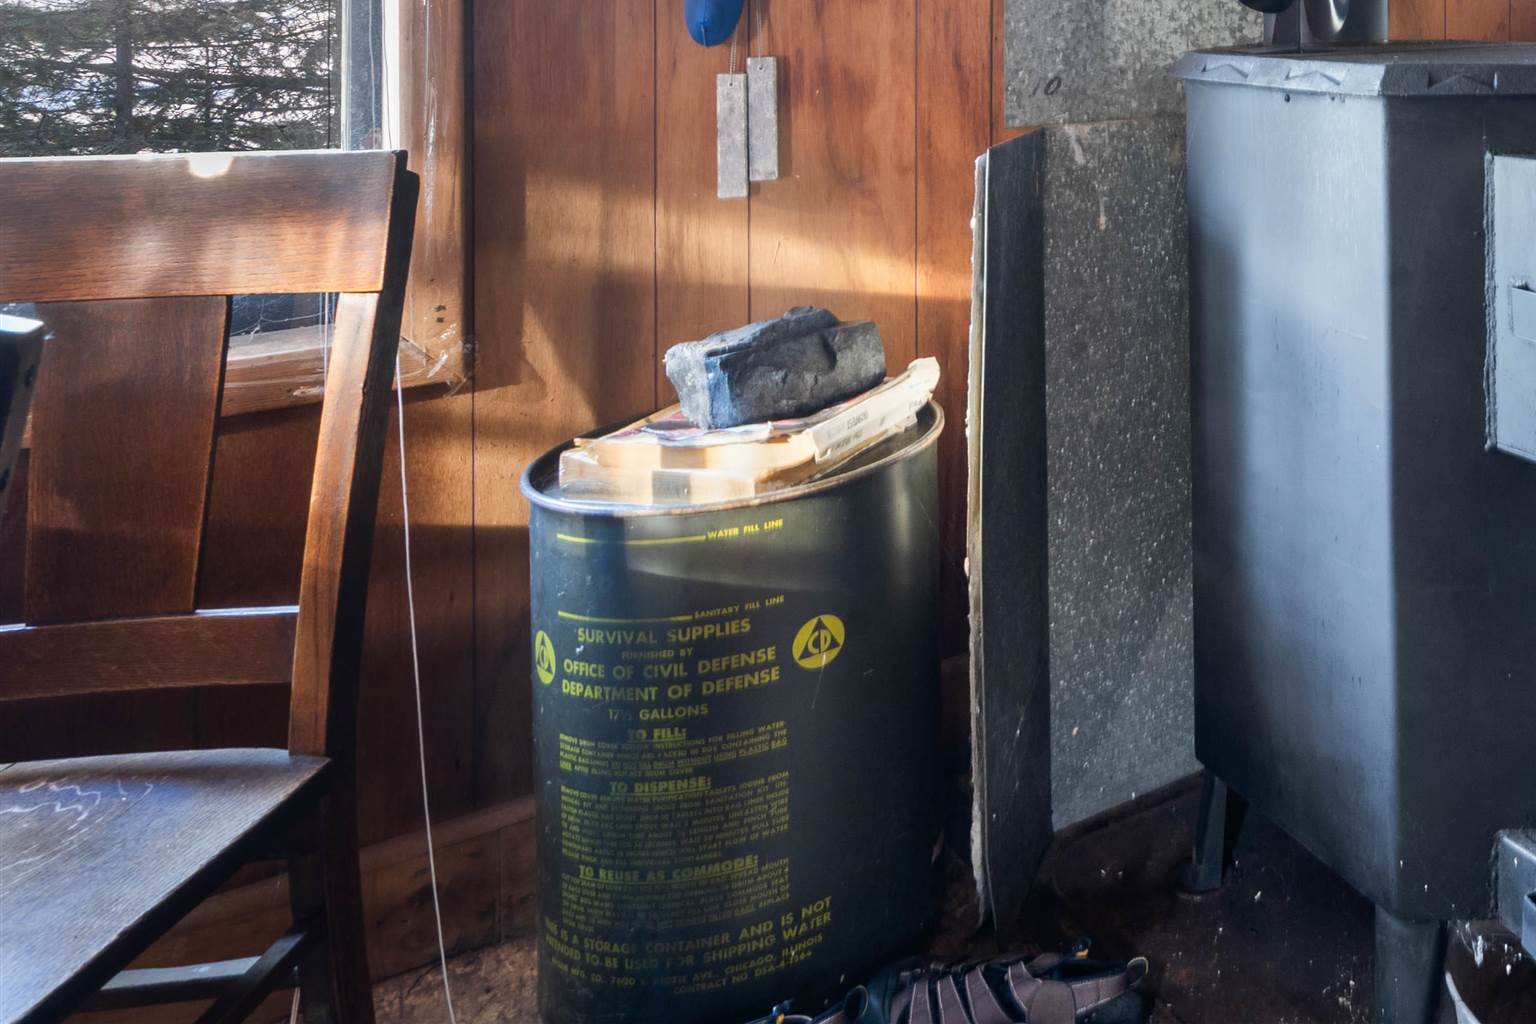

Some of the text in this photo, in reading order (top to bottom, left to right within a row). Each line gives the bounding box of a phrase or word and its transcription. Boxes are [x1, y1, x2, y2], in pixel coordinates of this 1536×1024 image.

[707, 518, 784, 540] WATER FILL LINE
[694, 594, 785, 618] SANITARY FILL LINE
[577, 618, 752, 645] SURVIVAL SUPPLIES
[563, 646, 777, 679] OFFICE OF CIVIL DEFENSE
[680, 647, 694, 657] BY
[562, 666, 781, 701] DEPARTMENT OF DEFENSE
[639, 703, 710, 721] GALLONS
[652, 727, 687, 740] FILL:
[609, 776, 712, 794] TO DISPENSE:
[578, 854, 759, 882] TO REUSE AS COMMODE:
[571, 933, 580, 945] A
[646, 932, 731, 954] CONTAINER
[738, 920, 774, 941] AND
[780, 911, 794, 928] IS
[800, 895, 833, 919] NOT
[585, 953, 600, 966] TO
[604, 957, 619, 969] BE
[624, 959, 659, 971] USED
[667, 954, 696, 968] FR
[703, 934, 777, 964] SHIPPING
[782, 912, 832, 942] WATER
[782, 932, 824, 959] ILLINOIS
[673, 979, 727, 995] CONTRACT
